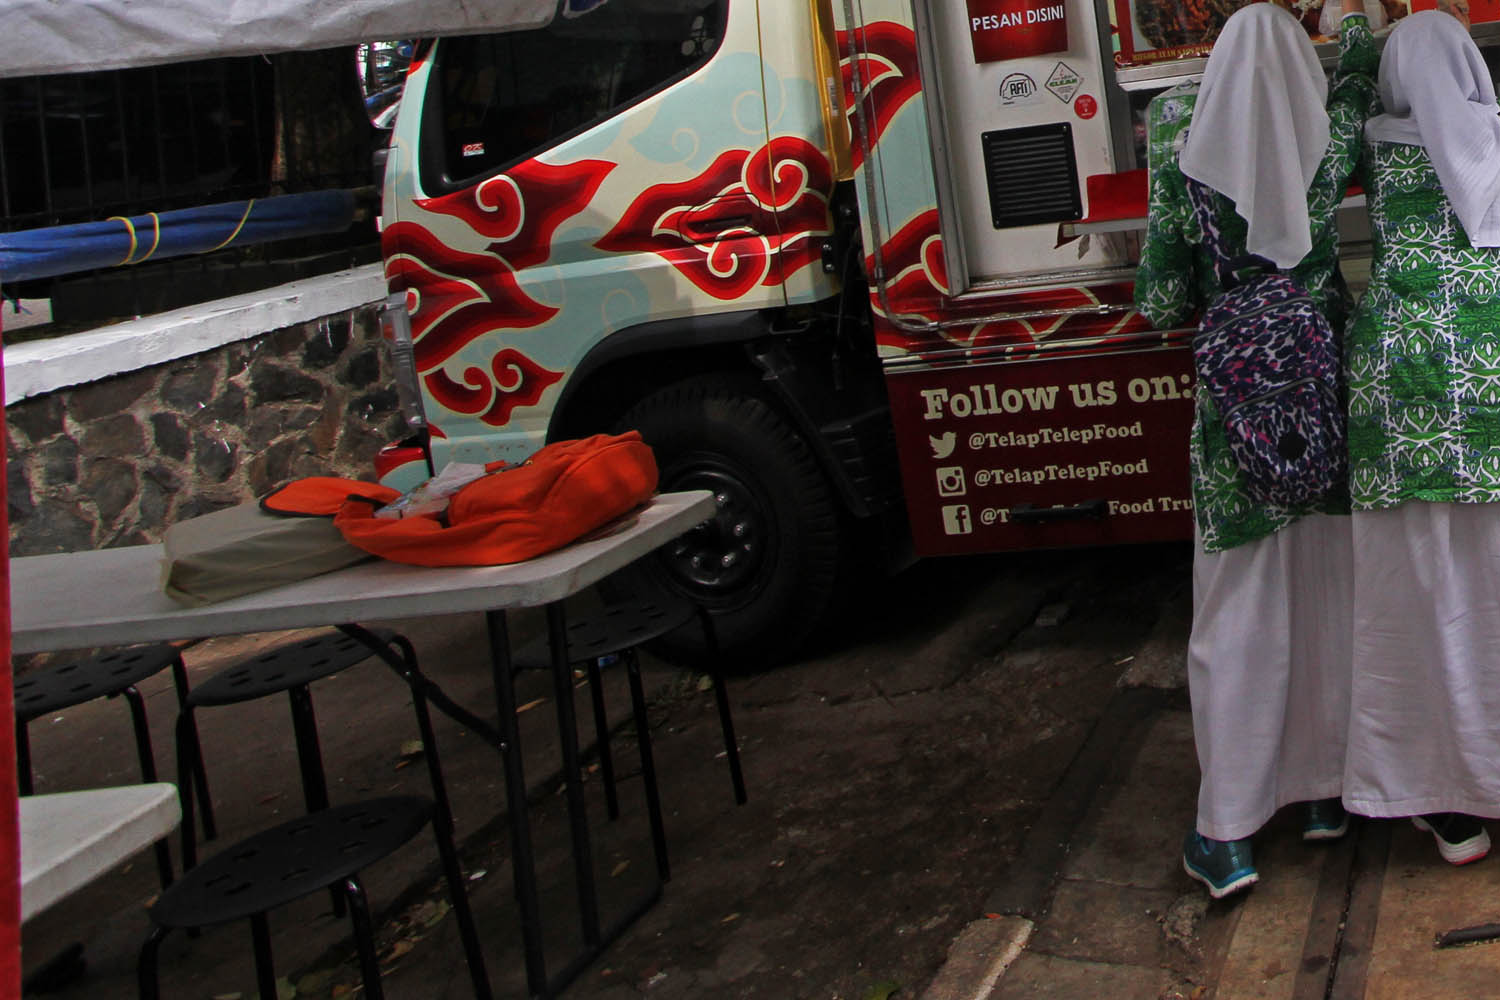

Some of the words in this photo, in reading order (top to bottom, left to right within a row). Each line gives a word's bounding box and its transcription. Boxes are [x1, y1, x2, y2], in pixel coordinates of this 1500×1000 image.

[972, 12, 1022, 31] PESAN
[1027, 5, 1064, 24] DISINI
[921, 384, 1059, 420] Follow
[1069, 380, 1117, 408] us
[1128, 373, 1193, 402] on:
[969, 421, 1143, 450] @TelapTelepFood
[974, 458, 1149, 487] @TelapTelepFood
[1108, 498, 1154, 516] Food
[1158, 496, 1193, 512] Tru
